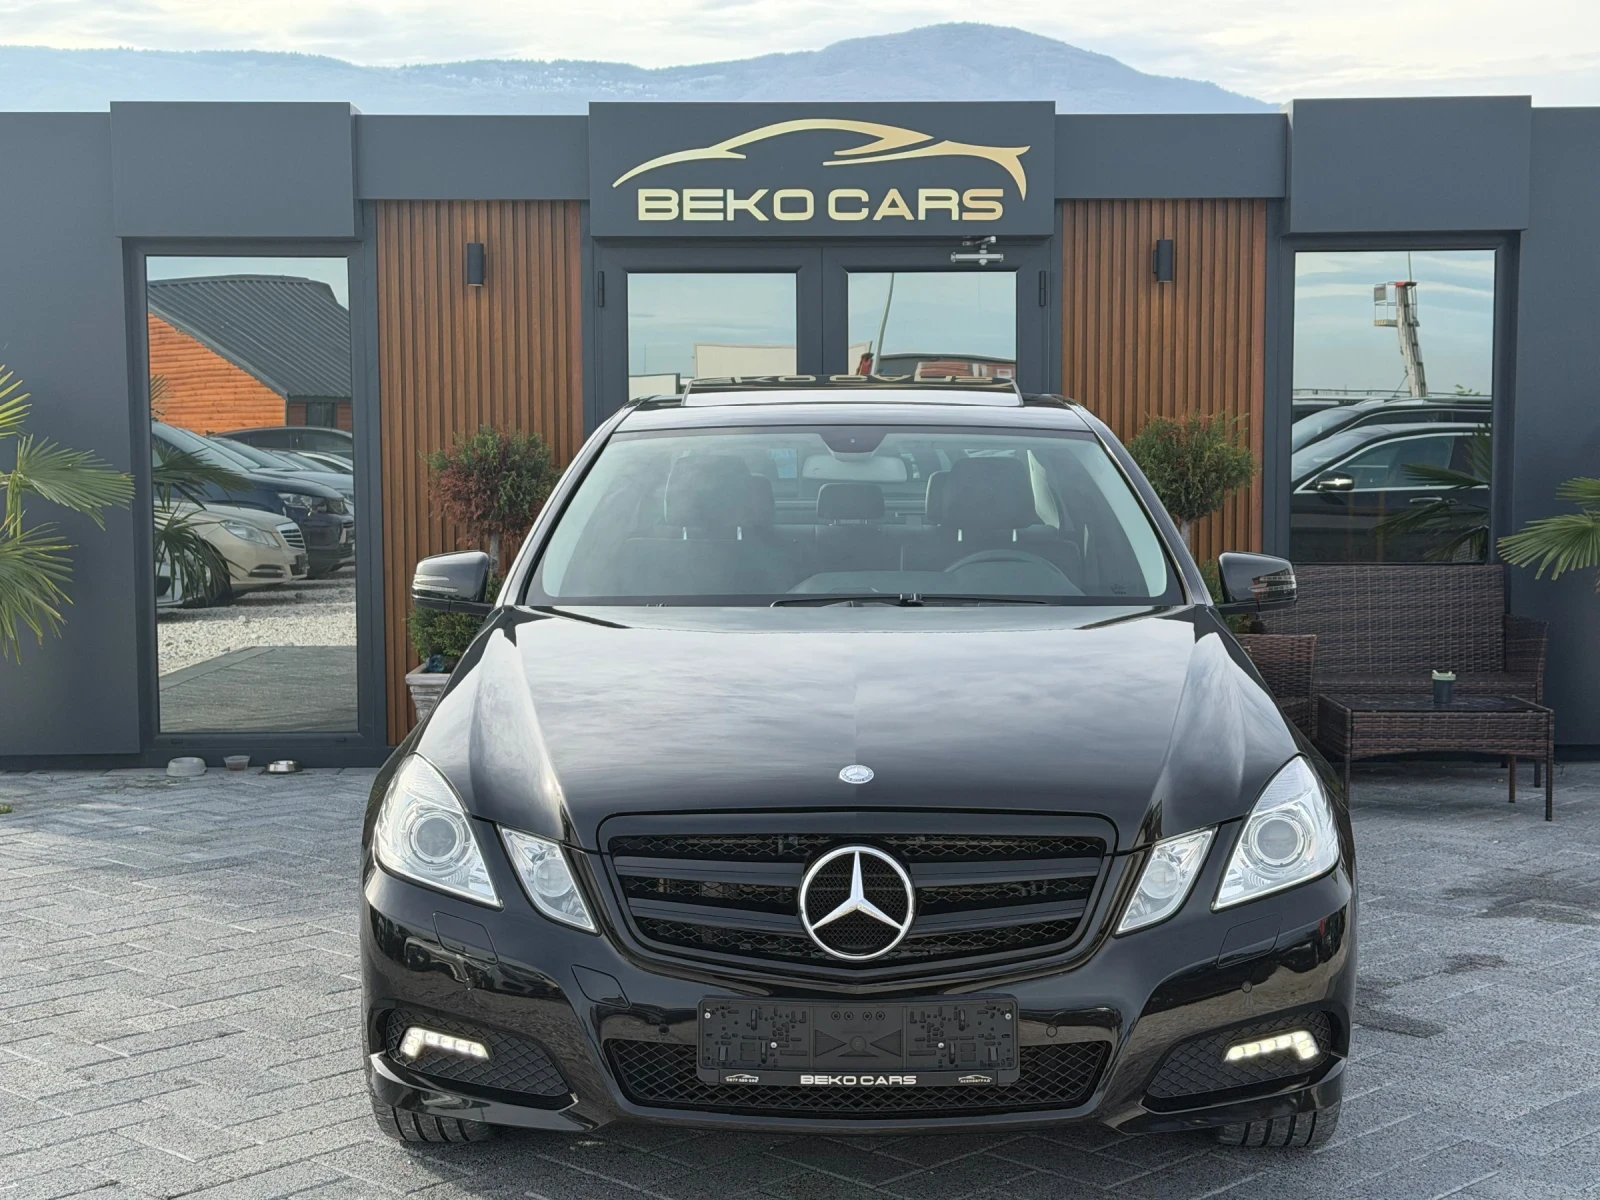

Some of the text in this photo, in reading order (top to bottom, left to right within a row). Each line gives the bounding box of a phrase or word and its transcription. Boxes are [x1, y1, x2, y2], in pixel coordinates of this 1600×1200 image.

[637, 188, 1004, 221] BEKO CARS
[800, 1075, 917, 1085] BEKO CARS
